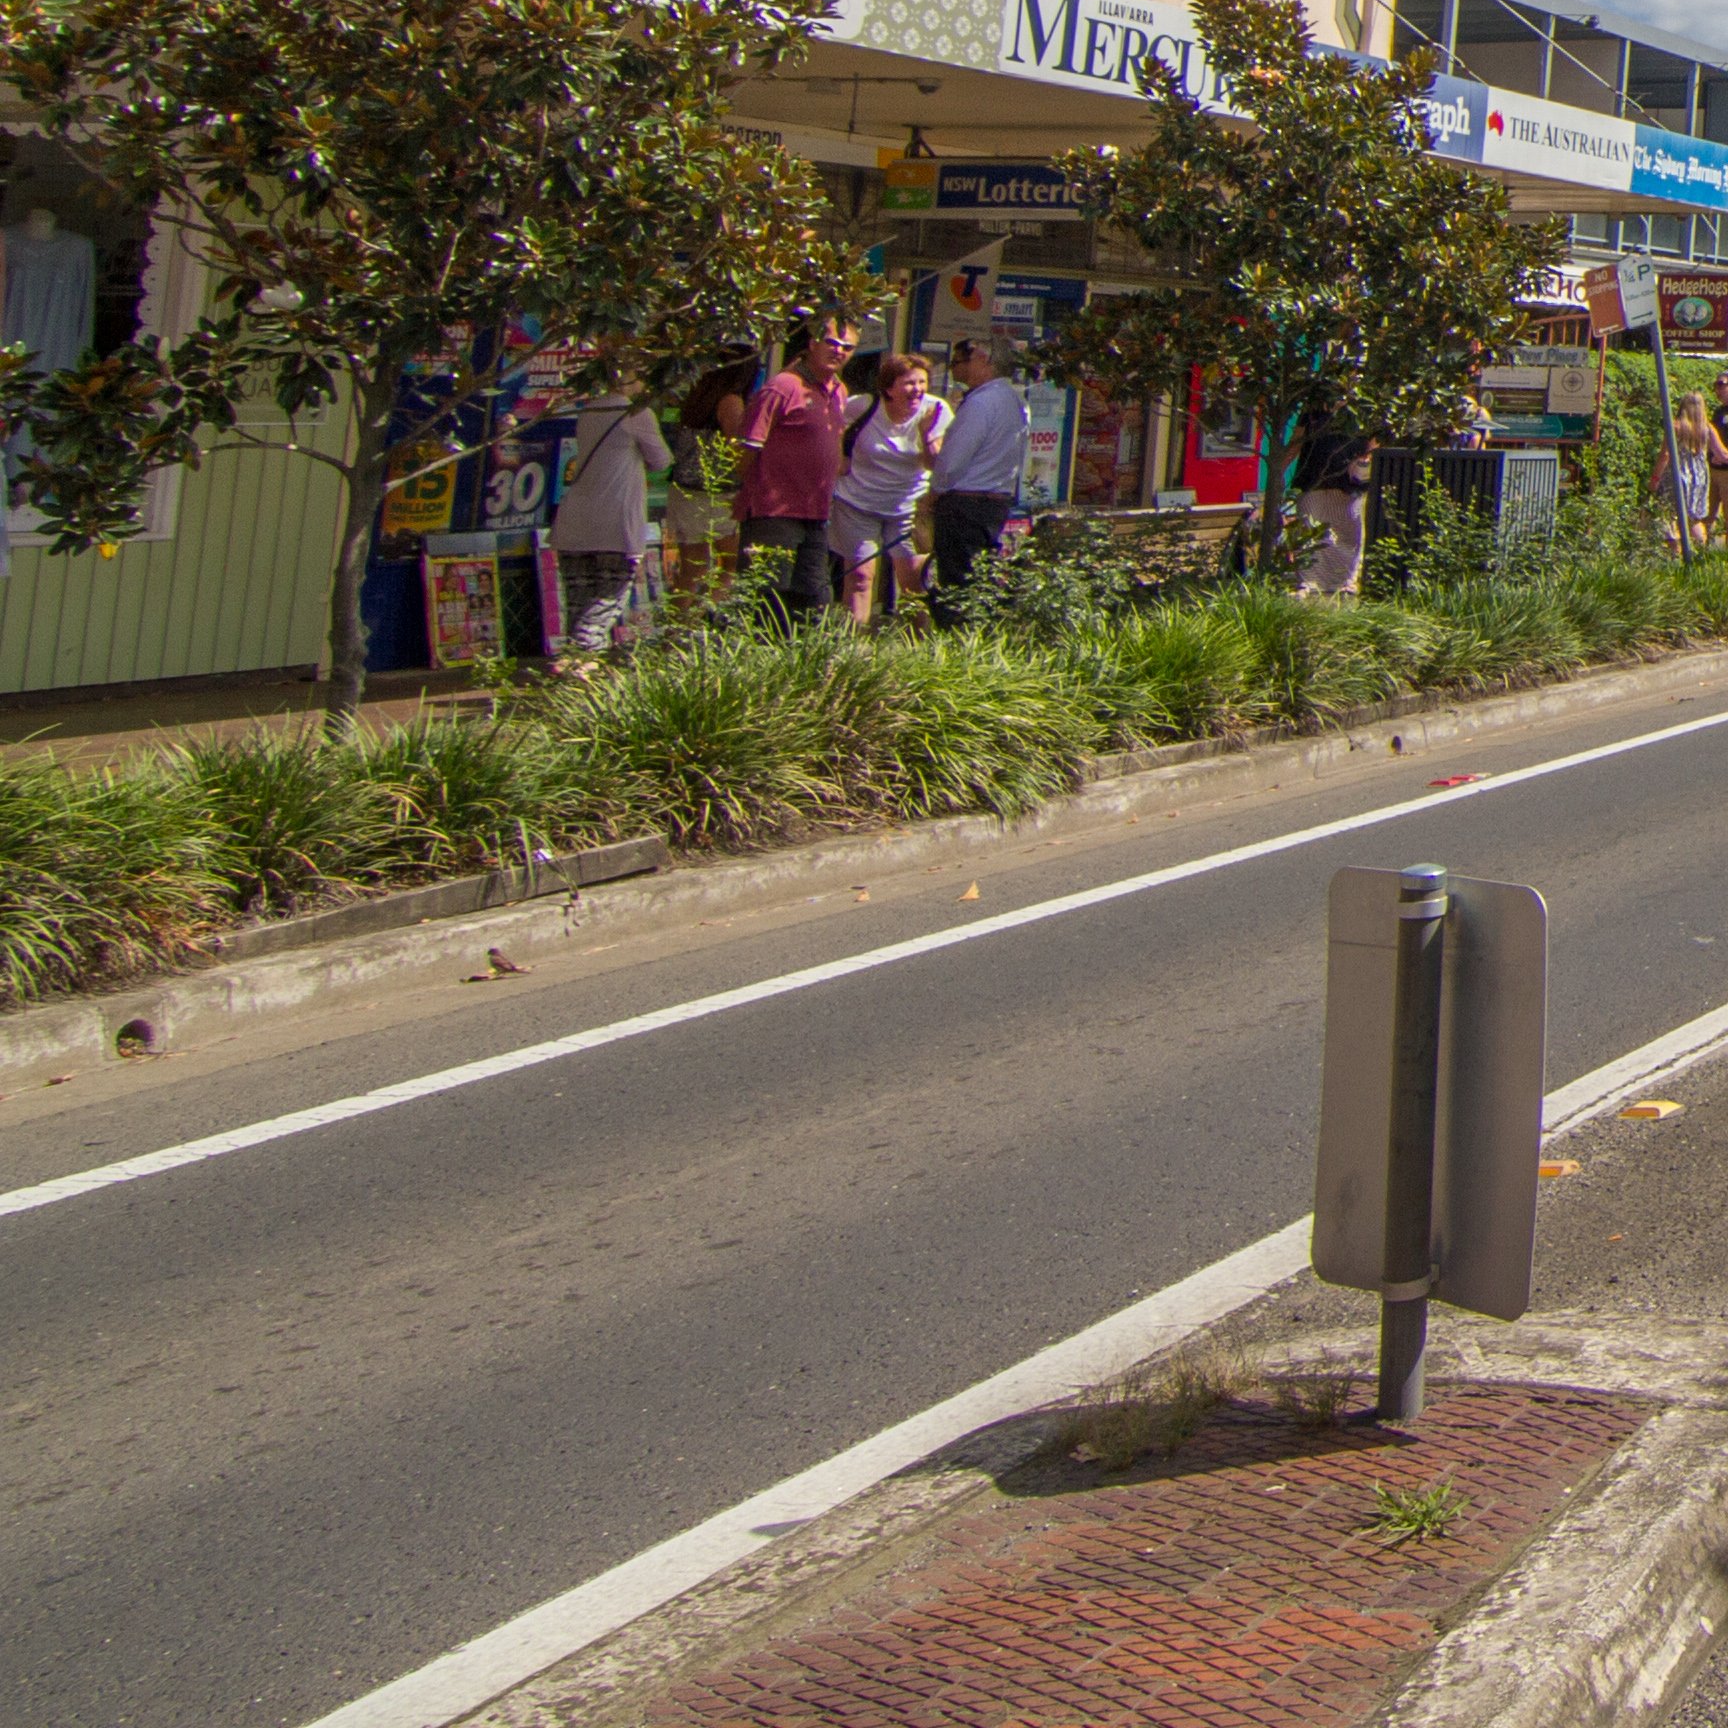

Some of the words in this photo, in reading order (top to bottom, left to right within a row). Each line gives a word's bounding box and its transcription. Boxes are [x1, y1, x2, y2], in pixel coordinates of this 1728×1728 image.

[1510, 116, 1540, 145] THE
[1540, 122, 1631, 163] AUSTRALIAN
[1634, 145, 1652, 171] The
[943, 176, 977, 192] NSW
[1594, 270, 1608, 283] NO
[1662, 276, 1728, 299] HedgeHogs
[1662, 329, 1695, 339] COFFEE
[1698, 329, 1726, 339] SHOP
[484, 462, 545, 516] 30
[486, 514, 535, 528] MILLION
